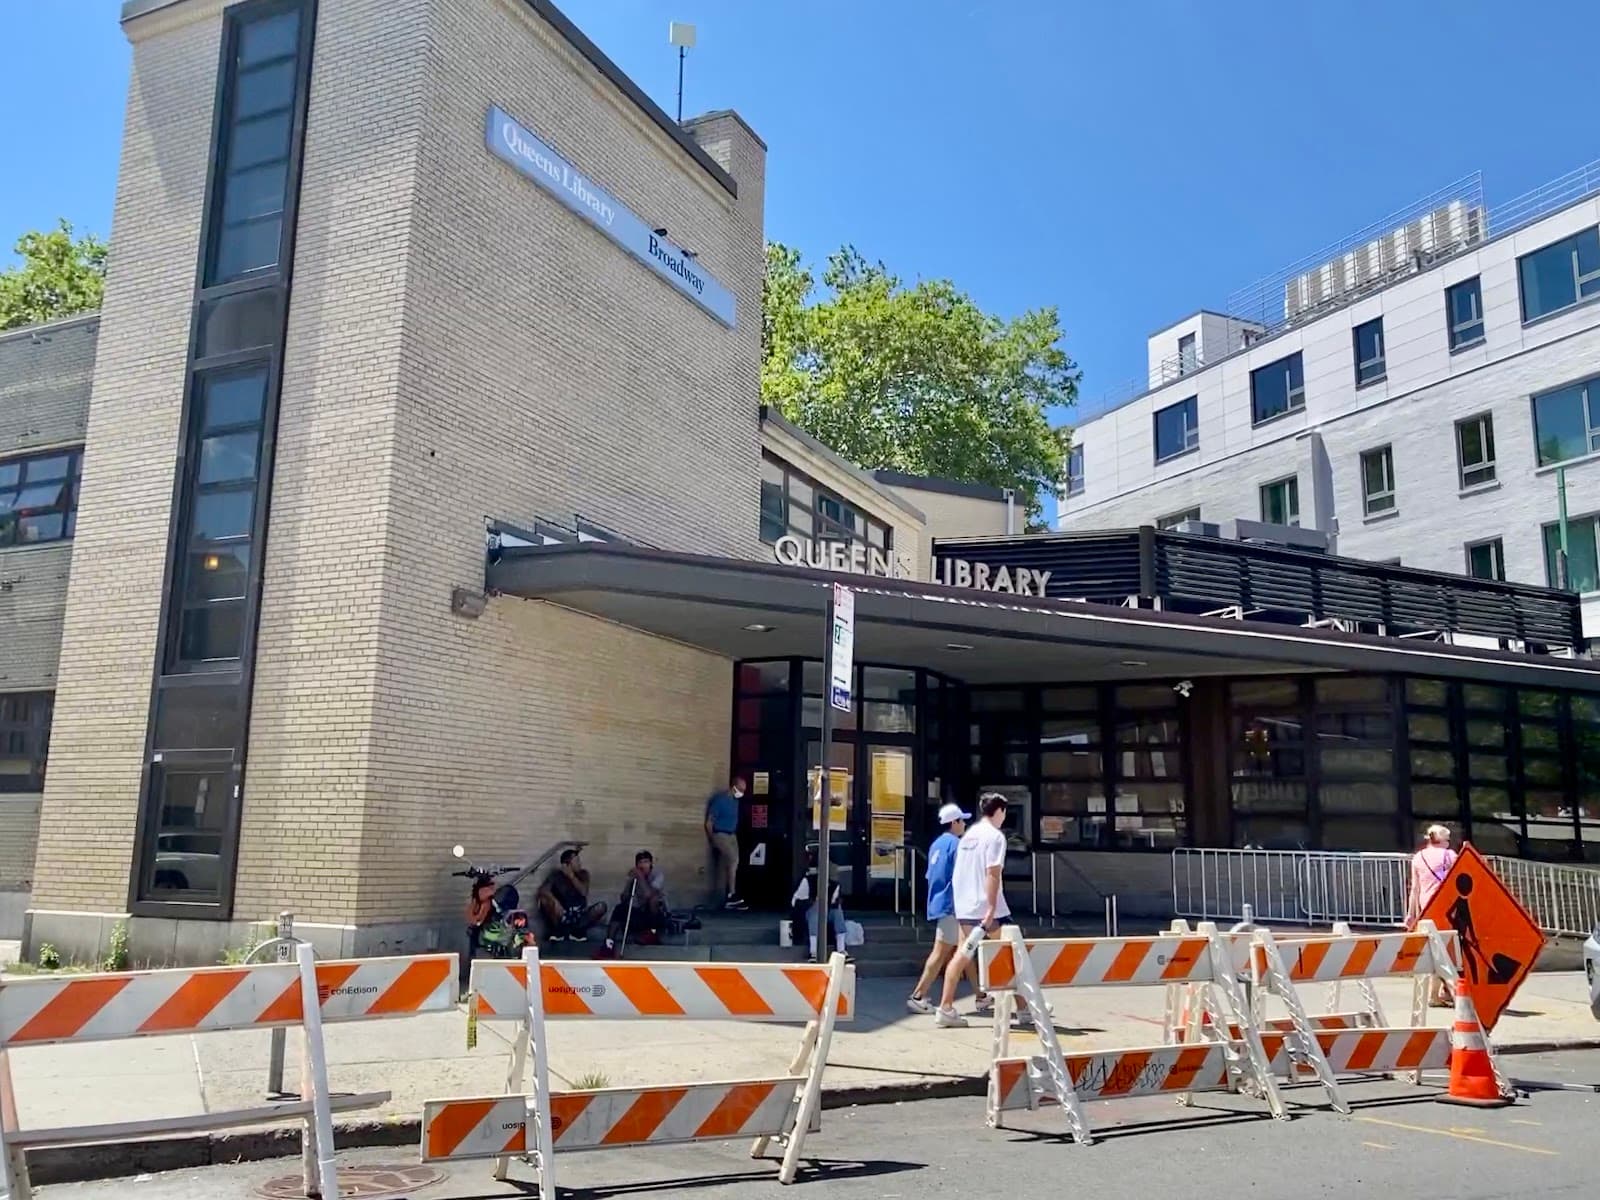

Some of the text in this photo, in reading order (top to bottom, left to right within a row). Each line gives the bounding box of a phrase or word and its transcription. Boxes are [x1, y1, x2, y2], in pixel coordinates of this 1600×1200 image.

[503, 122, 705, 294] Queens Library Broadway
[774, 535, 1052, 598] QUEENS LIBRARY
[330, 986, 378, 996] conEdison
